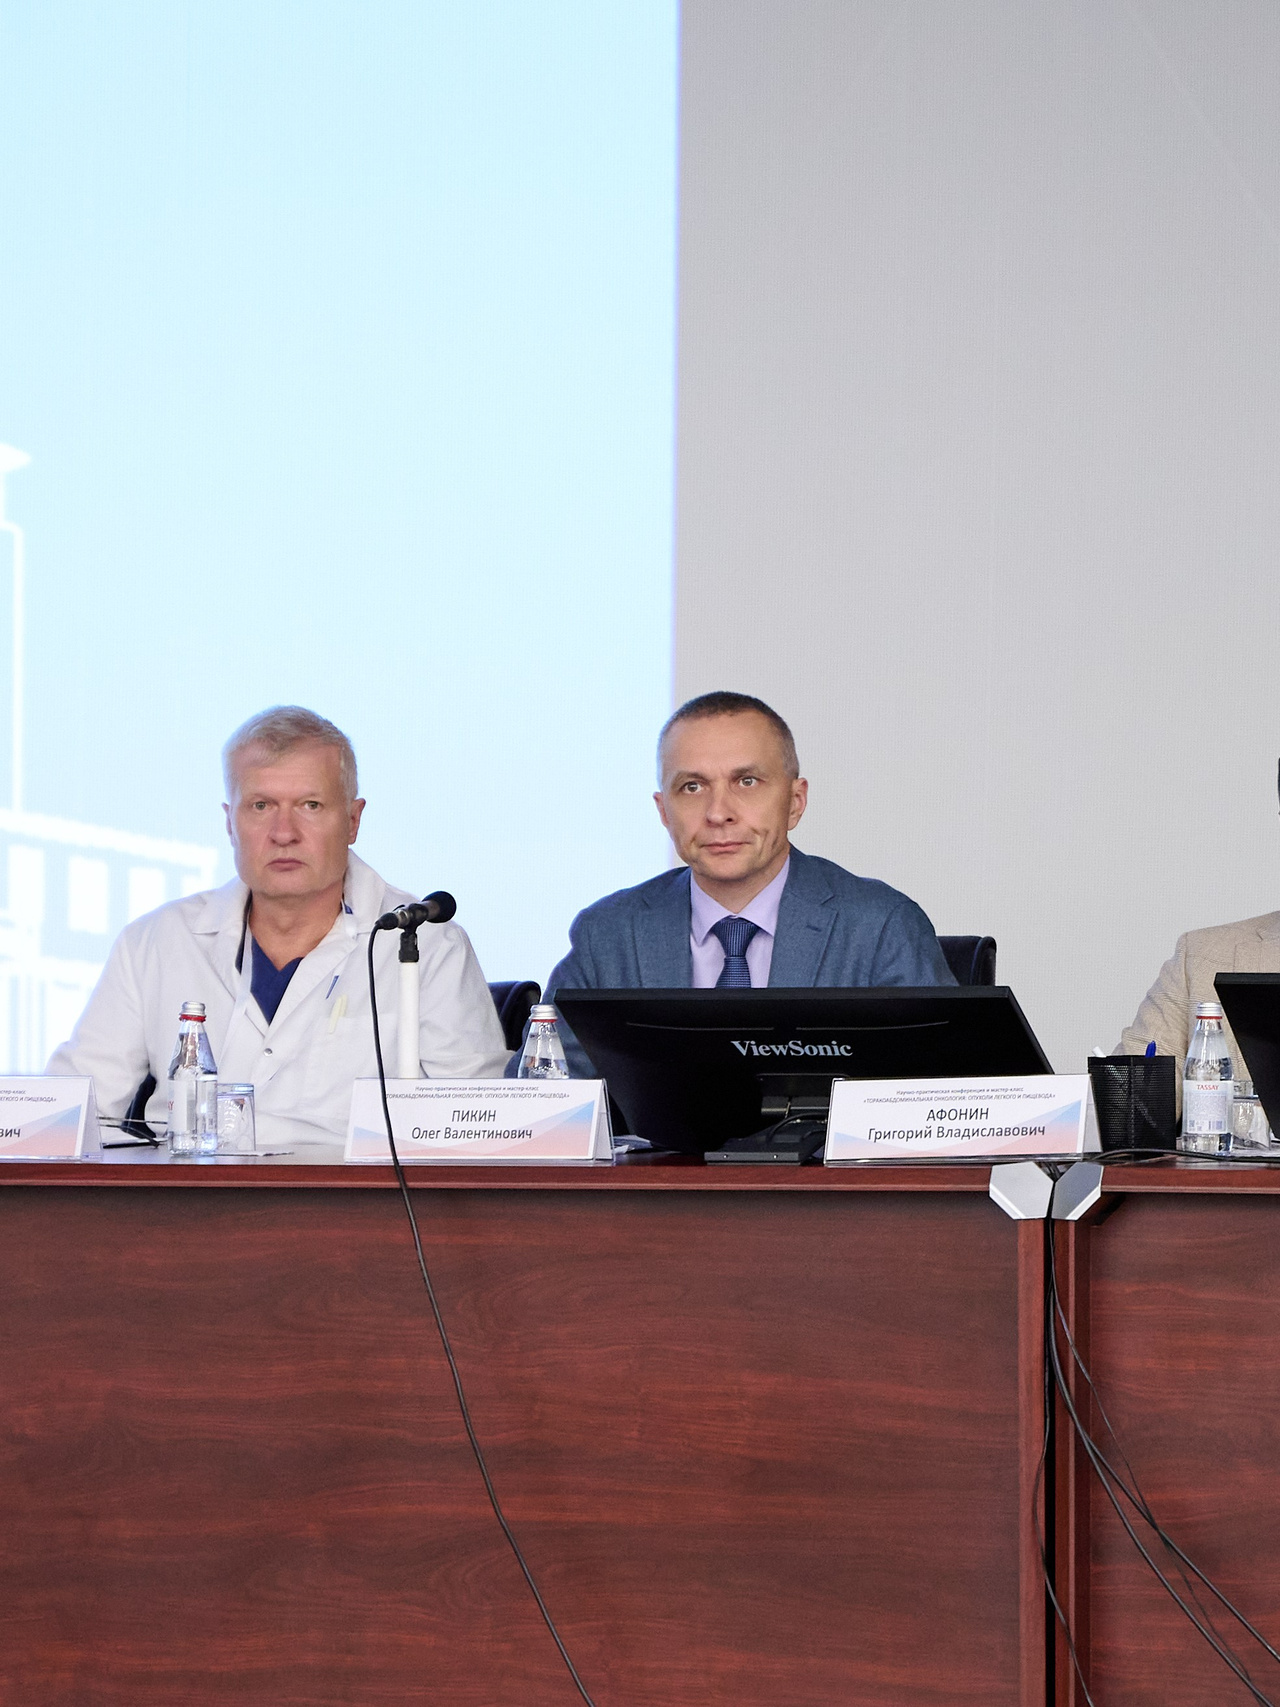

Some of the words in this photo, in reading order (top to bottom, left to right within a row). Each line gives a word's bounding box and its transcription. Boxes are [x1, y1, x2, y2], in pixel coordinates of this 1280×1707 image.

[730, 1040, 853, 1057] ViewSonic
[451, 1110, 497, 1122] ПИКИН
[926, 1107, 989, 1121] АФОНИН
[411, 1126, 441, 1139] Олег
[444, 1126, 533, 1139] Валентинович
[868, 1125, 932, 1143] Григорий
[936, 1126, 1046, 1140] Владиславович
